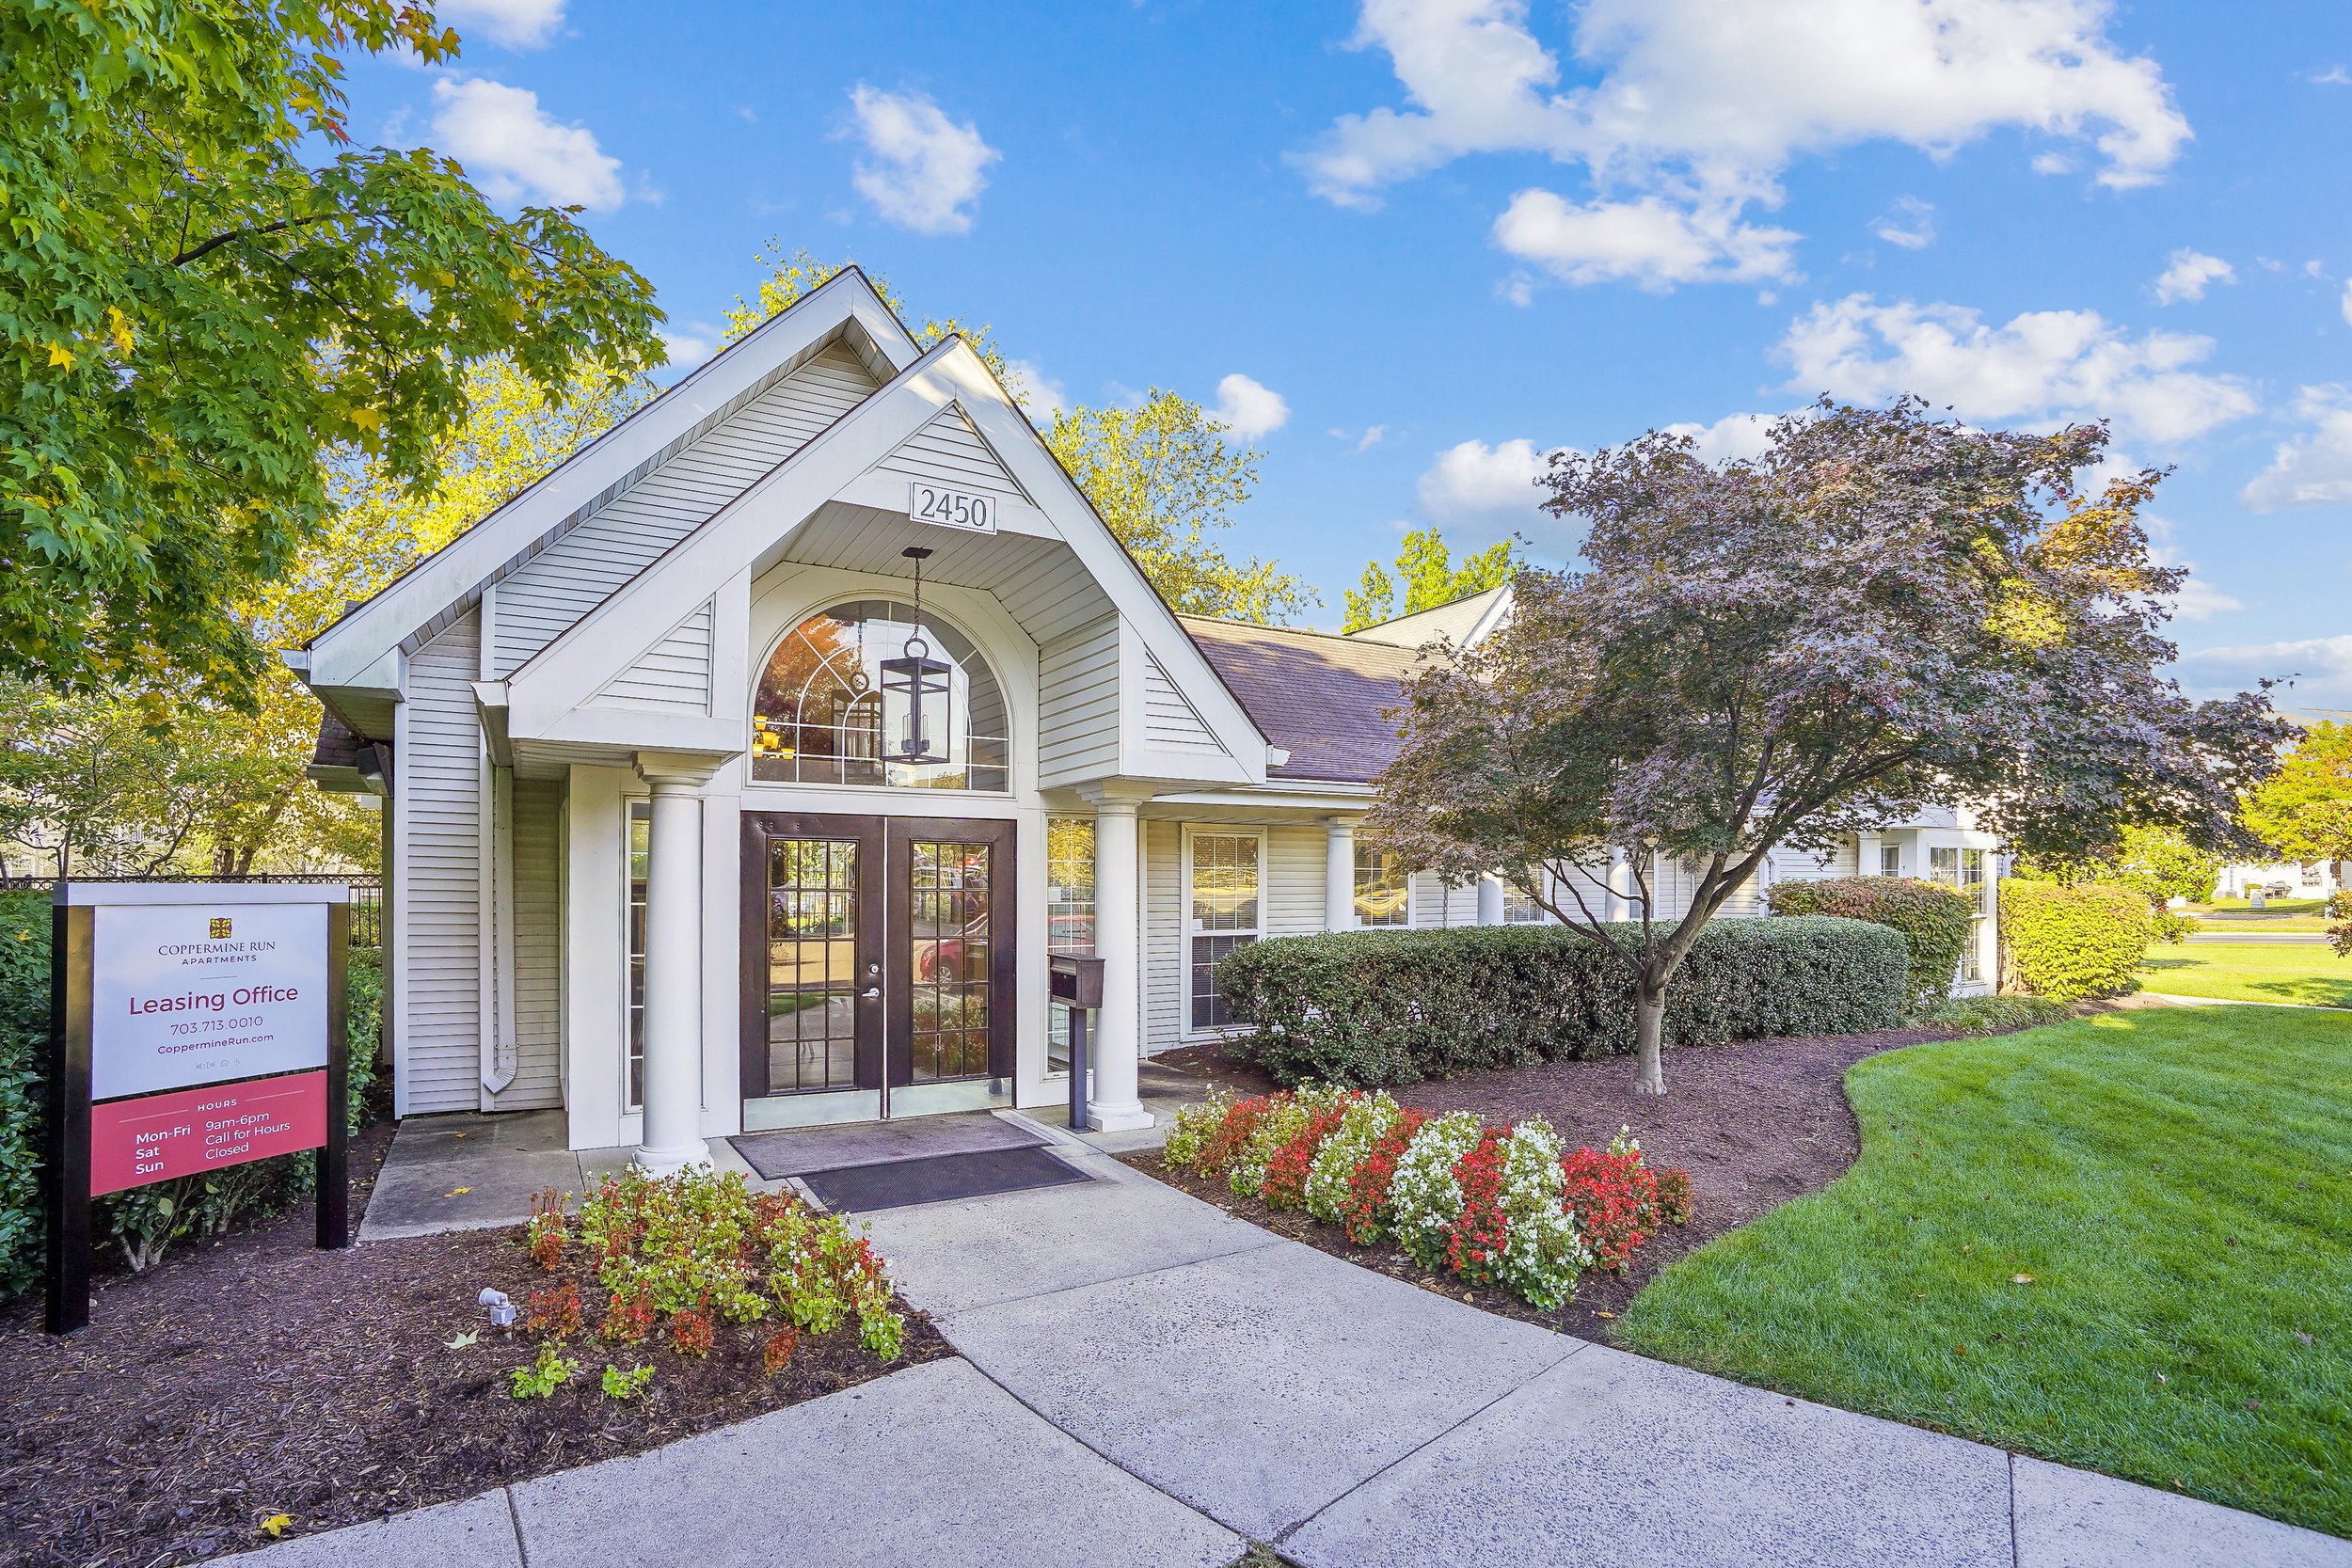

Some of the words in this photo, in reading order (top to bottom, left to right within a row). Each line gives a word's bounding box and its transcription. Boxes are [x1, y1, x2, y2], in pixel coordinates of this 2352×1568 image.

[920, 488, 987, 527] 2450
[158, 942, 246, 956] COPPERMINE
[249, 942, 276, 952] RUN
[182, 955, 257, 966] APARTMENTS
[130, 991, 225, 1015] Leasing
[232, 986, 298, 1006] Office
[170, 1016, 263, 1036] 703.713.0010
[157, 1035, 274, 1054] CoppermineRun.com
[198, 1099, 237, 1113] HOURS
[135, 1124, 191, 1145] Mon-Fri
[205, 1112, 270, 1132] 9am-6pm
[135, 1146, 160, 1160] Sat
[205, 1131, 230, 1146] Call
[233, 1129, 250, 1141] for
[254, 1122, 291, 1136] Hours
[135, 1161, 165, 1175] Sun
[205, 1142, 249, 1160] Closed
